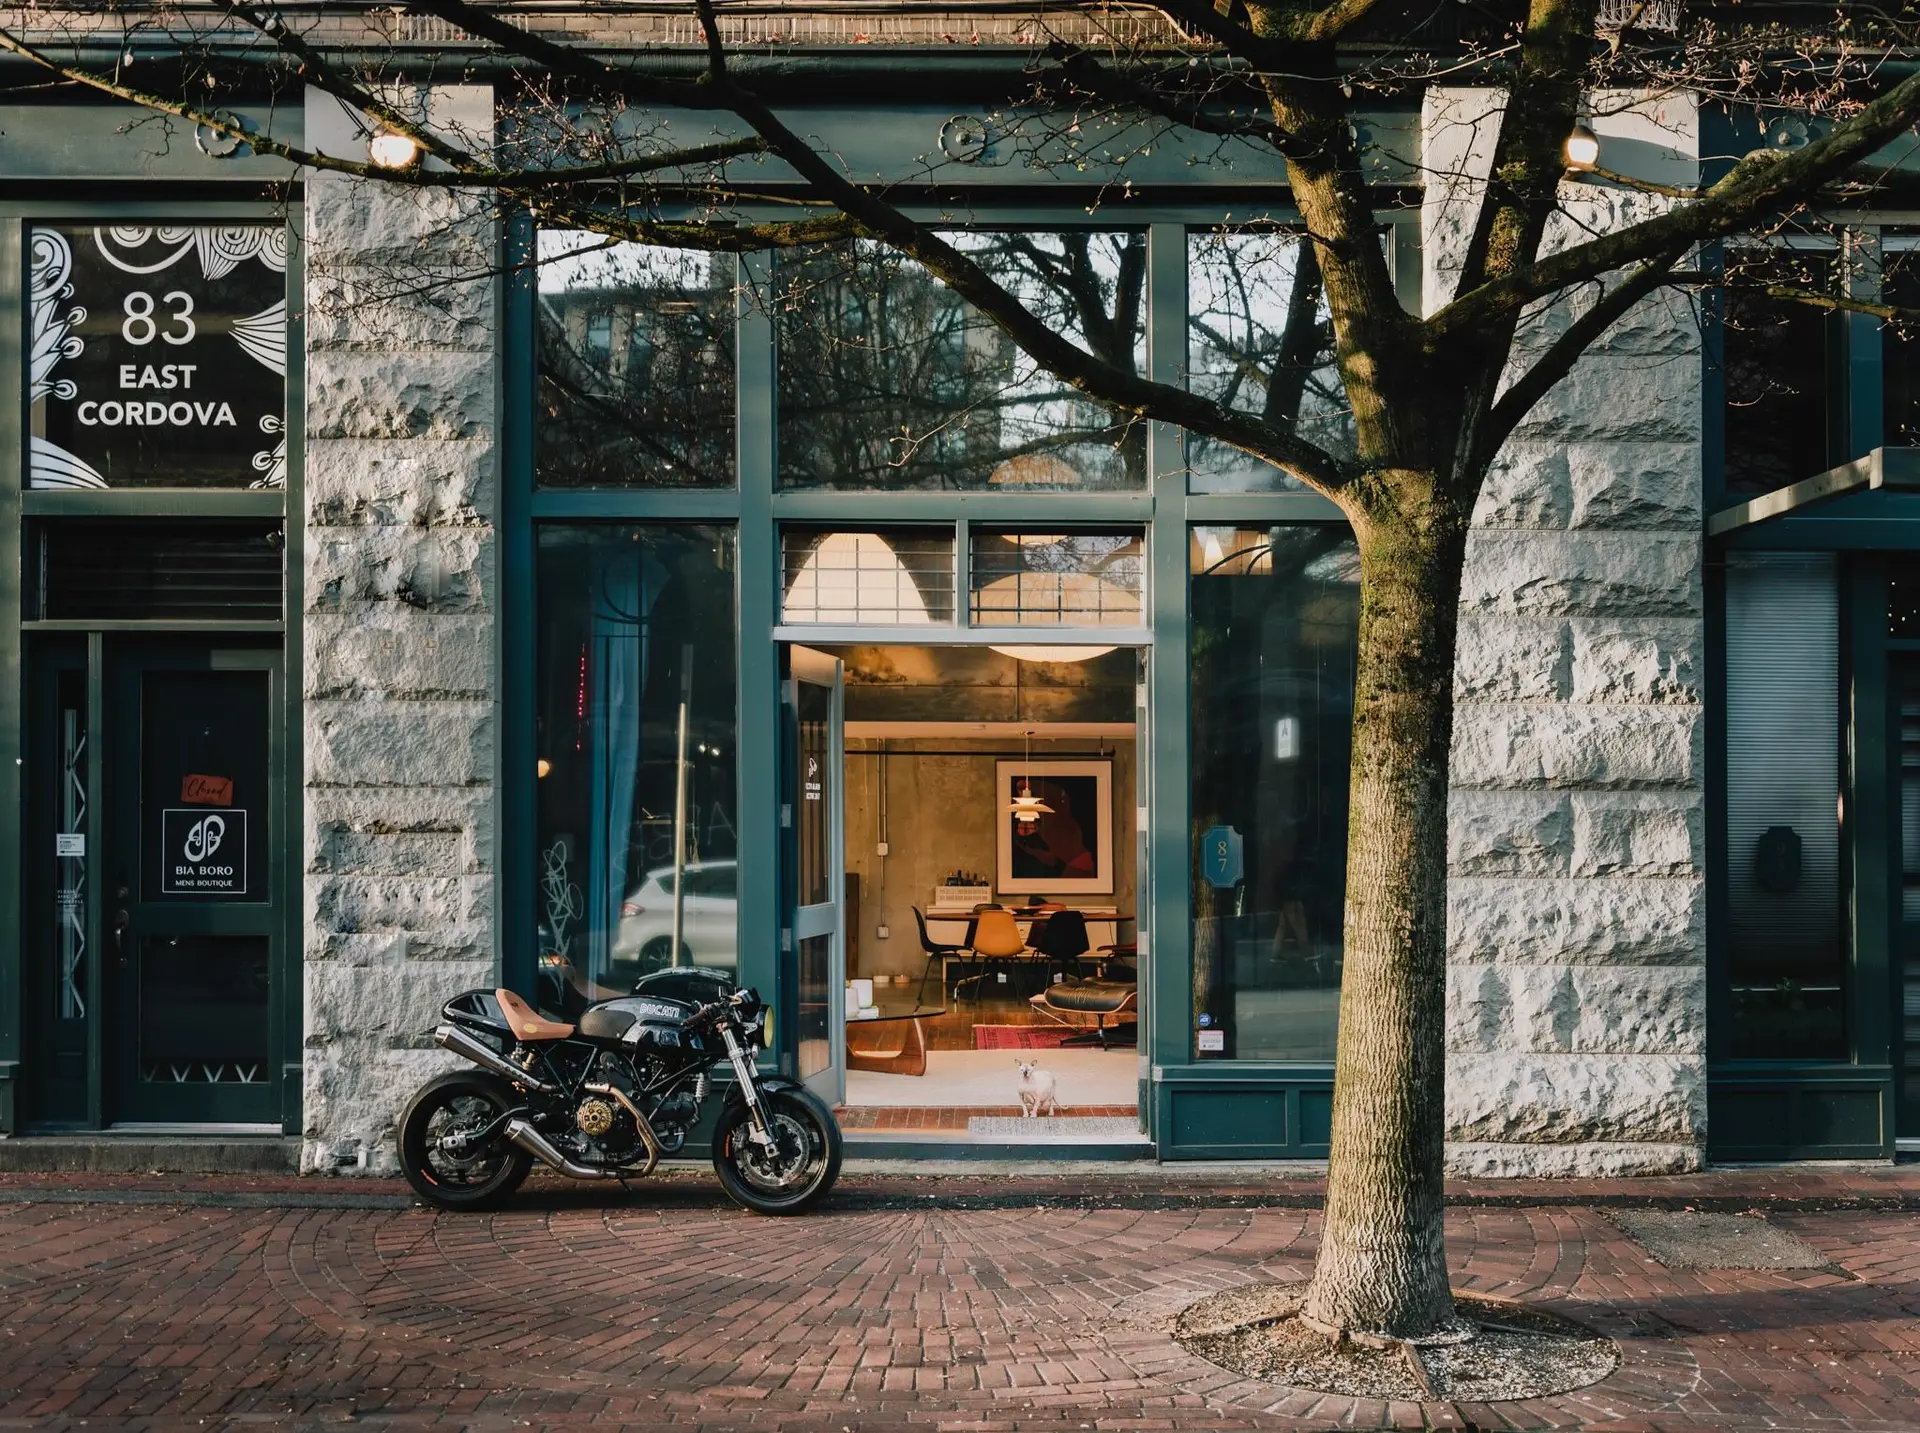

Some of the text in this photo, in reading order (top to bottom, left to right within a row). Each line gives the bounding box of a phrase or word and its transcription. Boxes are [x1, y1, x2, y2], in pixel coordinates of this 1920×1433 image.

[122, 291, 196, 346] 83
[120, 364, 197, 389] EAST
[77, 401, 237, 426] CORDOVA
[175, 866, 233, 876] BIA BORO
[197, 880, 233, 888] BOUTIQUE
[639, 1003, 680, 1018] DUCATI
